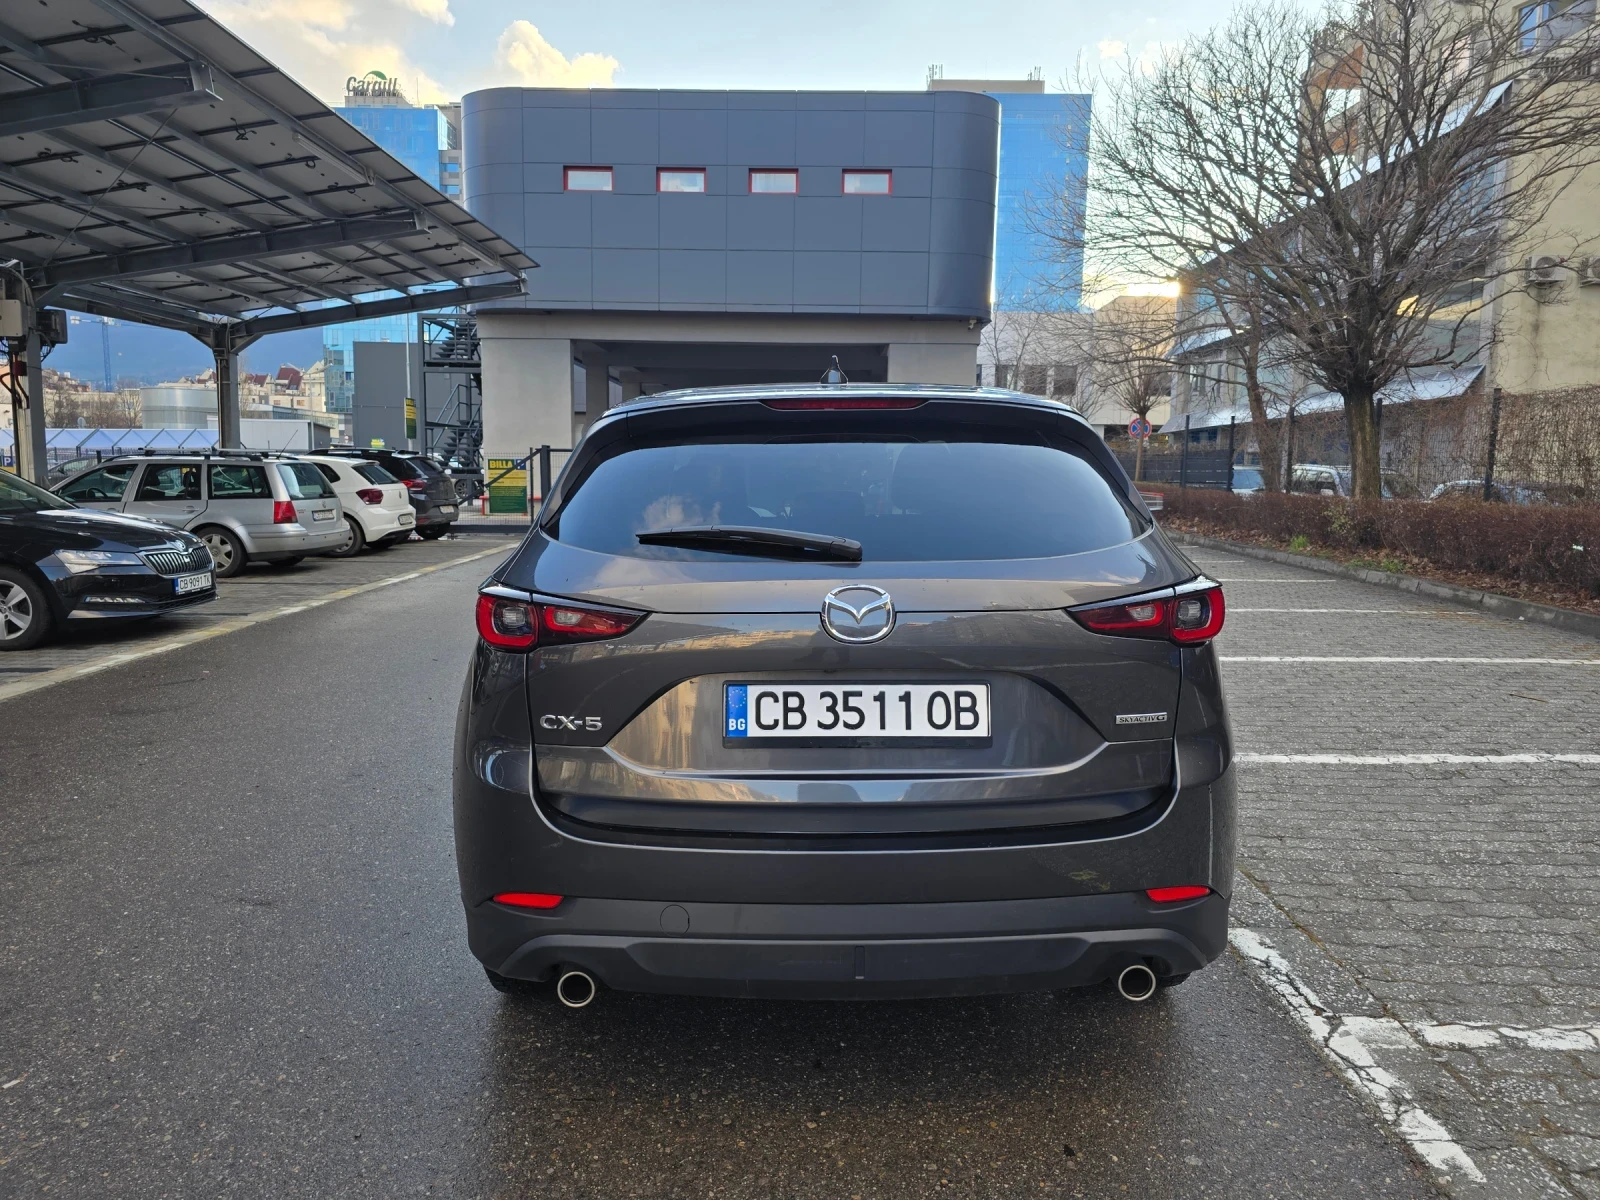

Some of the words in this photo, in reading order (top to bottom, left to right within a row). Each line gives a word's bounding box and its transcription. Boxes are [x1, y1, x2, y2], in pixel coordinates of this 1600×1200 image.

[346, 76, 398, 96] Cargill
[4, 457, 11, 467] P
[490, 460, 513, 469] BILLA
[180, 579, 188, 590] CB
[190, 576, 203, 588] 9091
[728, 718, 746, 731] BG
[755, 690, 807, 731] CB
[817, 690, 912, 731] 3511
[927, 690, 980, 731] OB
[539, 714, 603, 731] CX-5
